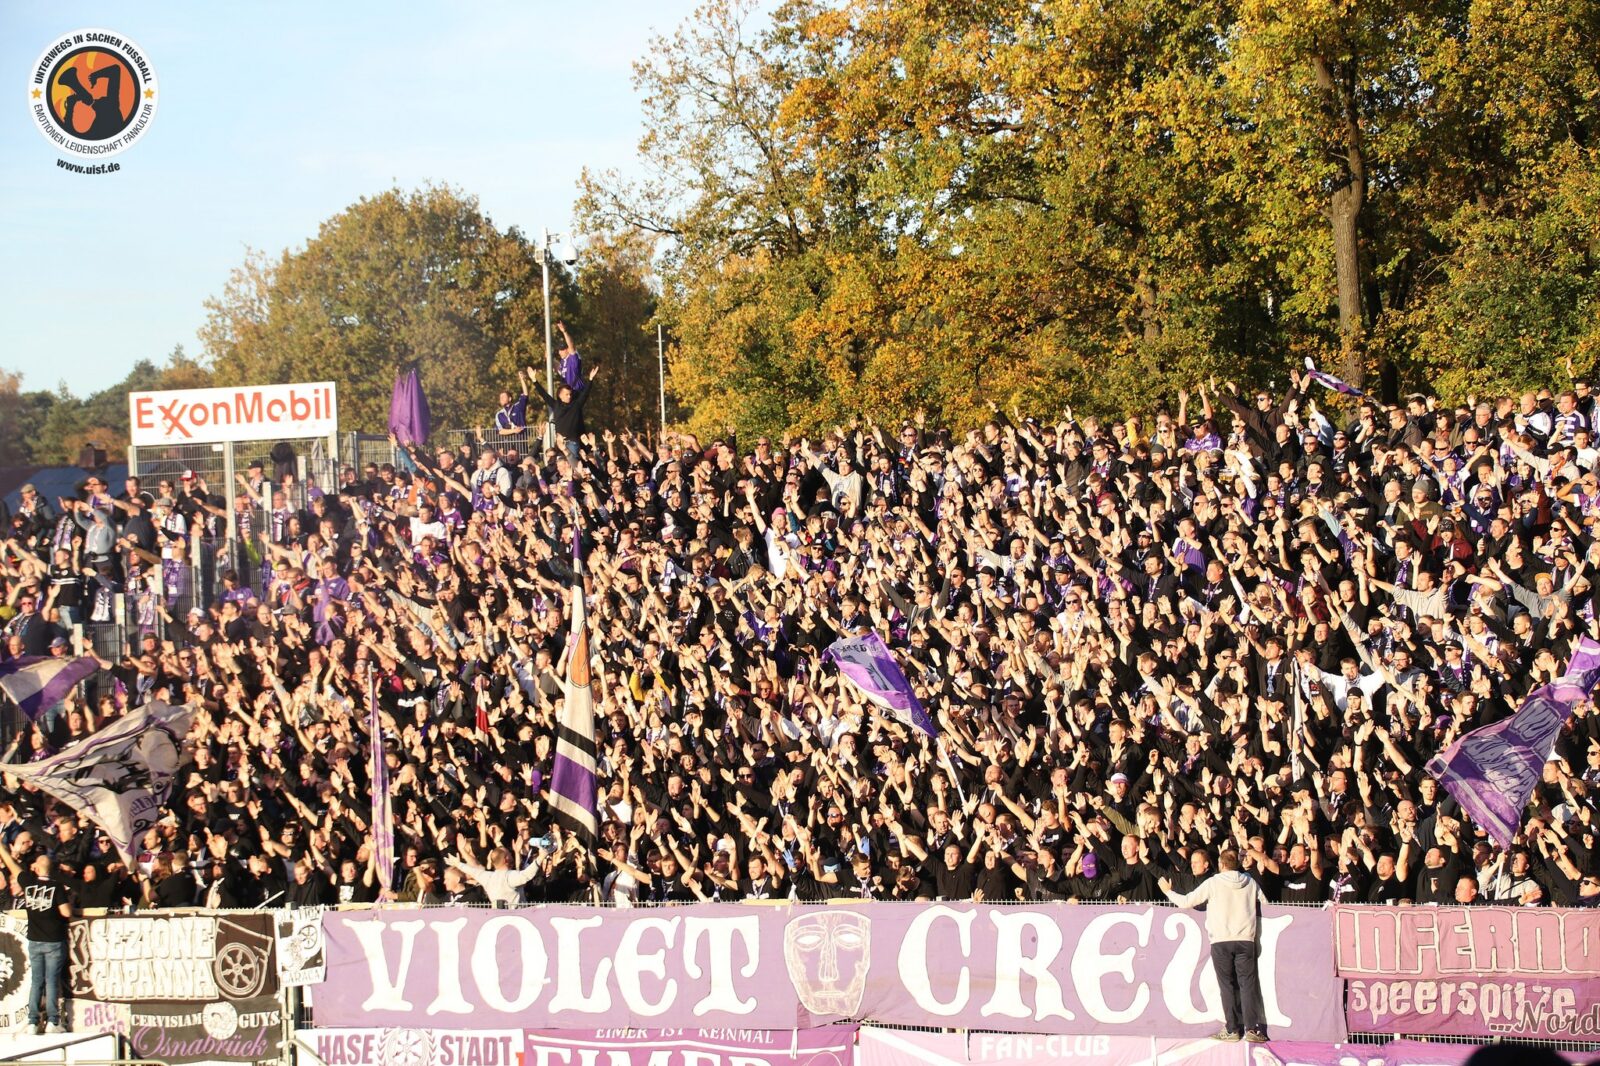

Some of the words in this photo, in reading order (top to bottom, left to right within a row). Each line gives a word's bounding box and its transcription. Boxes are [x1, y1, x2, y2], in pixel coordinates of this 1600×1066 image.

[136, 388, 331, 438] ExxonMobil
[342, 914, 760, 1017] VIOLET
[131, 1013, 204, 1028] CERVISIAM
[238, 1010, 280, 1029] GUYS
[130, 1025, 269, 1058] Osnabrück
[317, 1034, 375, 1066] HASE
[439, 1035, 512, 1066] STADT
[981, 1036, 1110, 1060] FAN-CLUB
